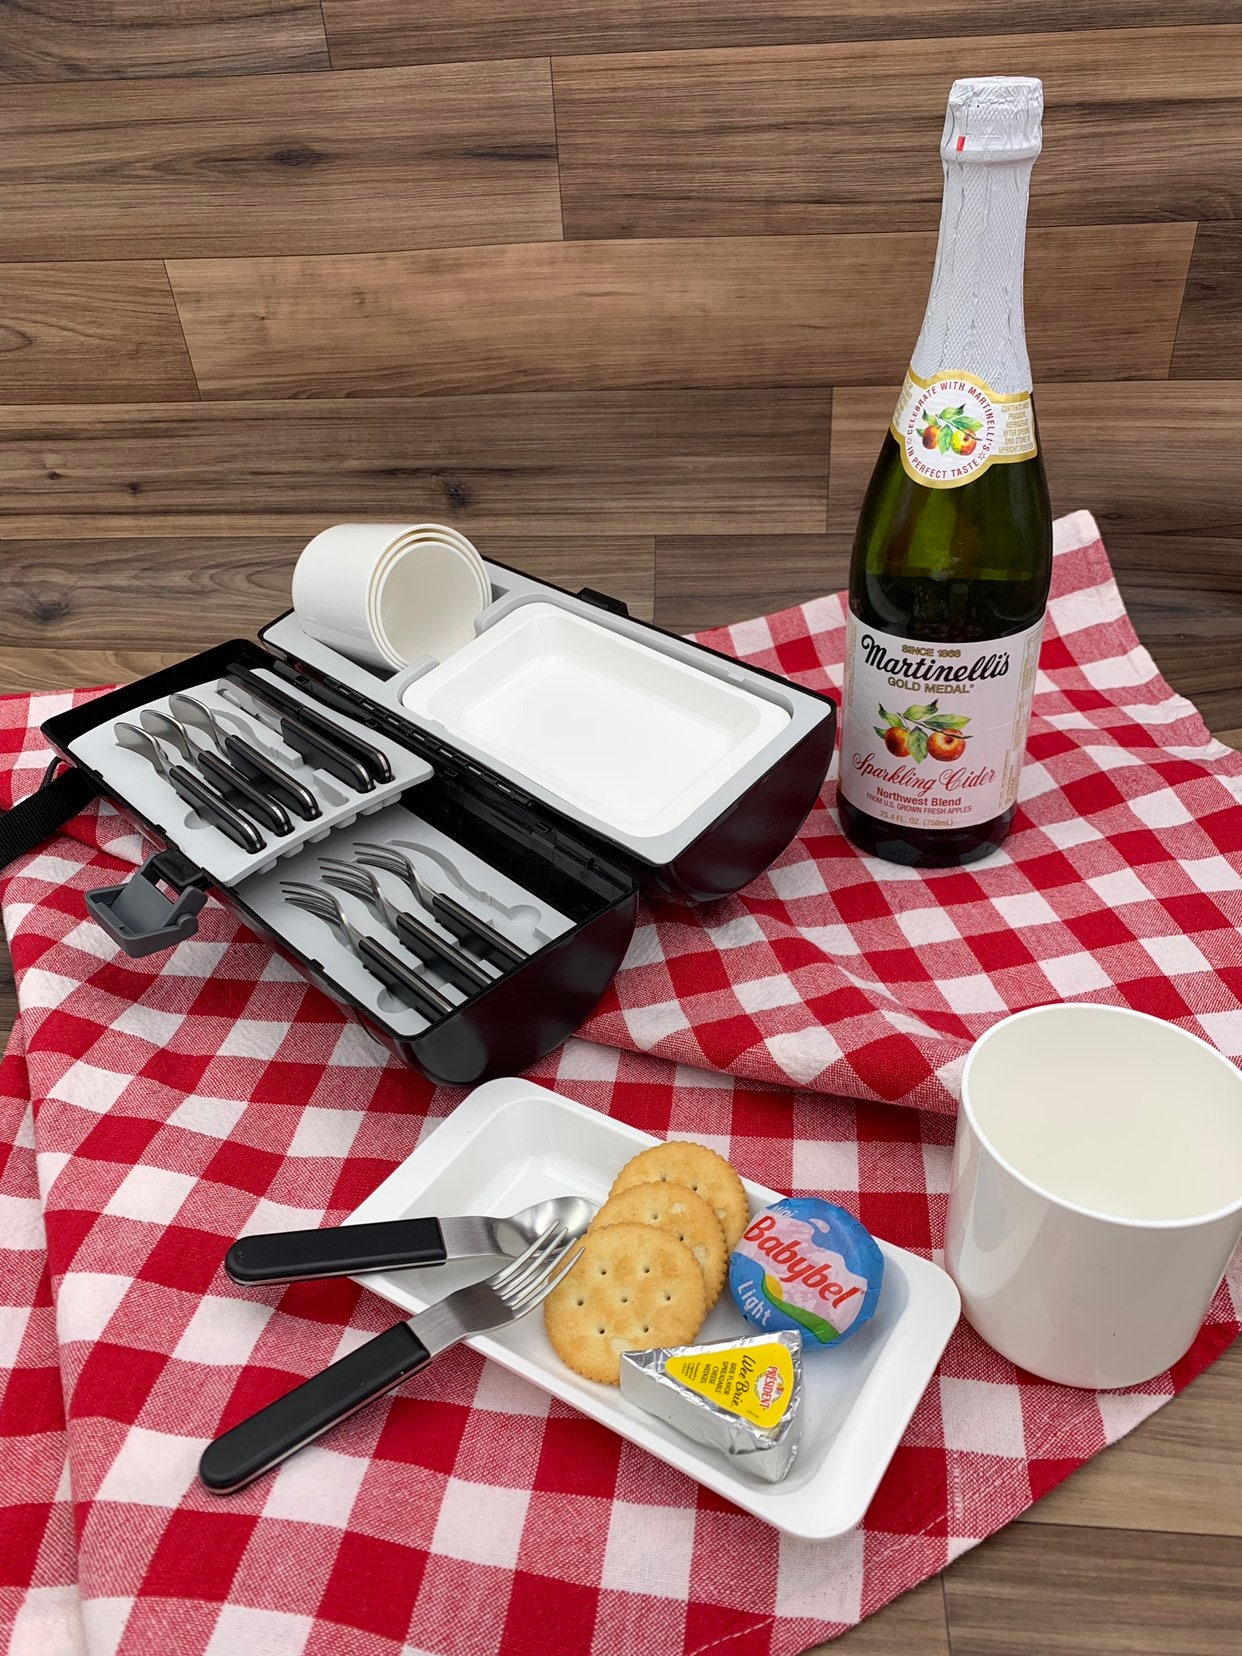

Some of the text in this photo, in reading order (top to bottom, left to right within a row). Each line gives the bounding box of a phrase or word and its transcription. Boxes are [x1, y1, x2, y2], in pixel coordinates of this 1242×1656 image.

[907, 386, 937, 435] CELEBRATE
[940, 381, 966, 391] WITH
[967, 386, 995, 452] MARTINELLI'S
[907, 446, 979, 479] IN PERFECT TASTE
[861, 634, 1010, 682] Martinelli's
[901, 644, 934, 657] SINCE
[887, 676, 921, 692] GOLD
[852, 752, 937, 797] Sparkling
[938, 767, 996, 792] Cider
[866, 792, 972, 815] FROM U.S. GROWN FRESH APPLES
[876, 786, 962, 807] Northwest Blend
[880, 810, 895, 820] 25.4
[896, 815, 907, 824] FL.
[743, 1215, 861, 1309] Babybel
[737, 1280, 772, 1326] Light
[700, 1363, 711, 1384] WEDGES
[708, 1366, 719, 1385] CHEESE
[714, 1360, 729, 1394] SPREADABLE
[723, 1362, 737, 1395] BRIE FLAVOR
[731, 1355, 757, 1407] Wee Brie
